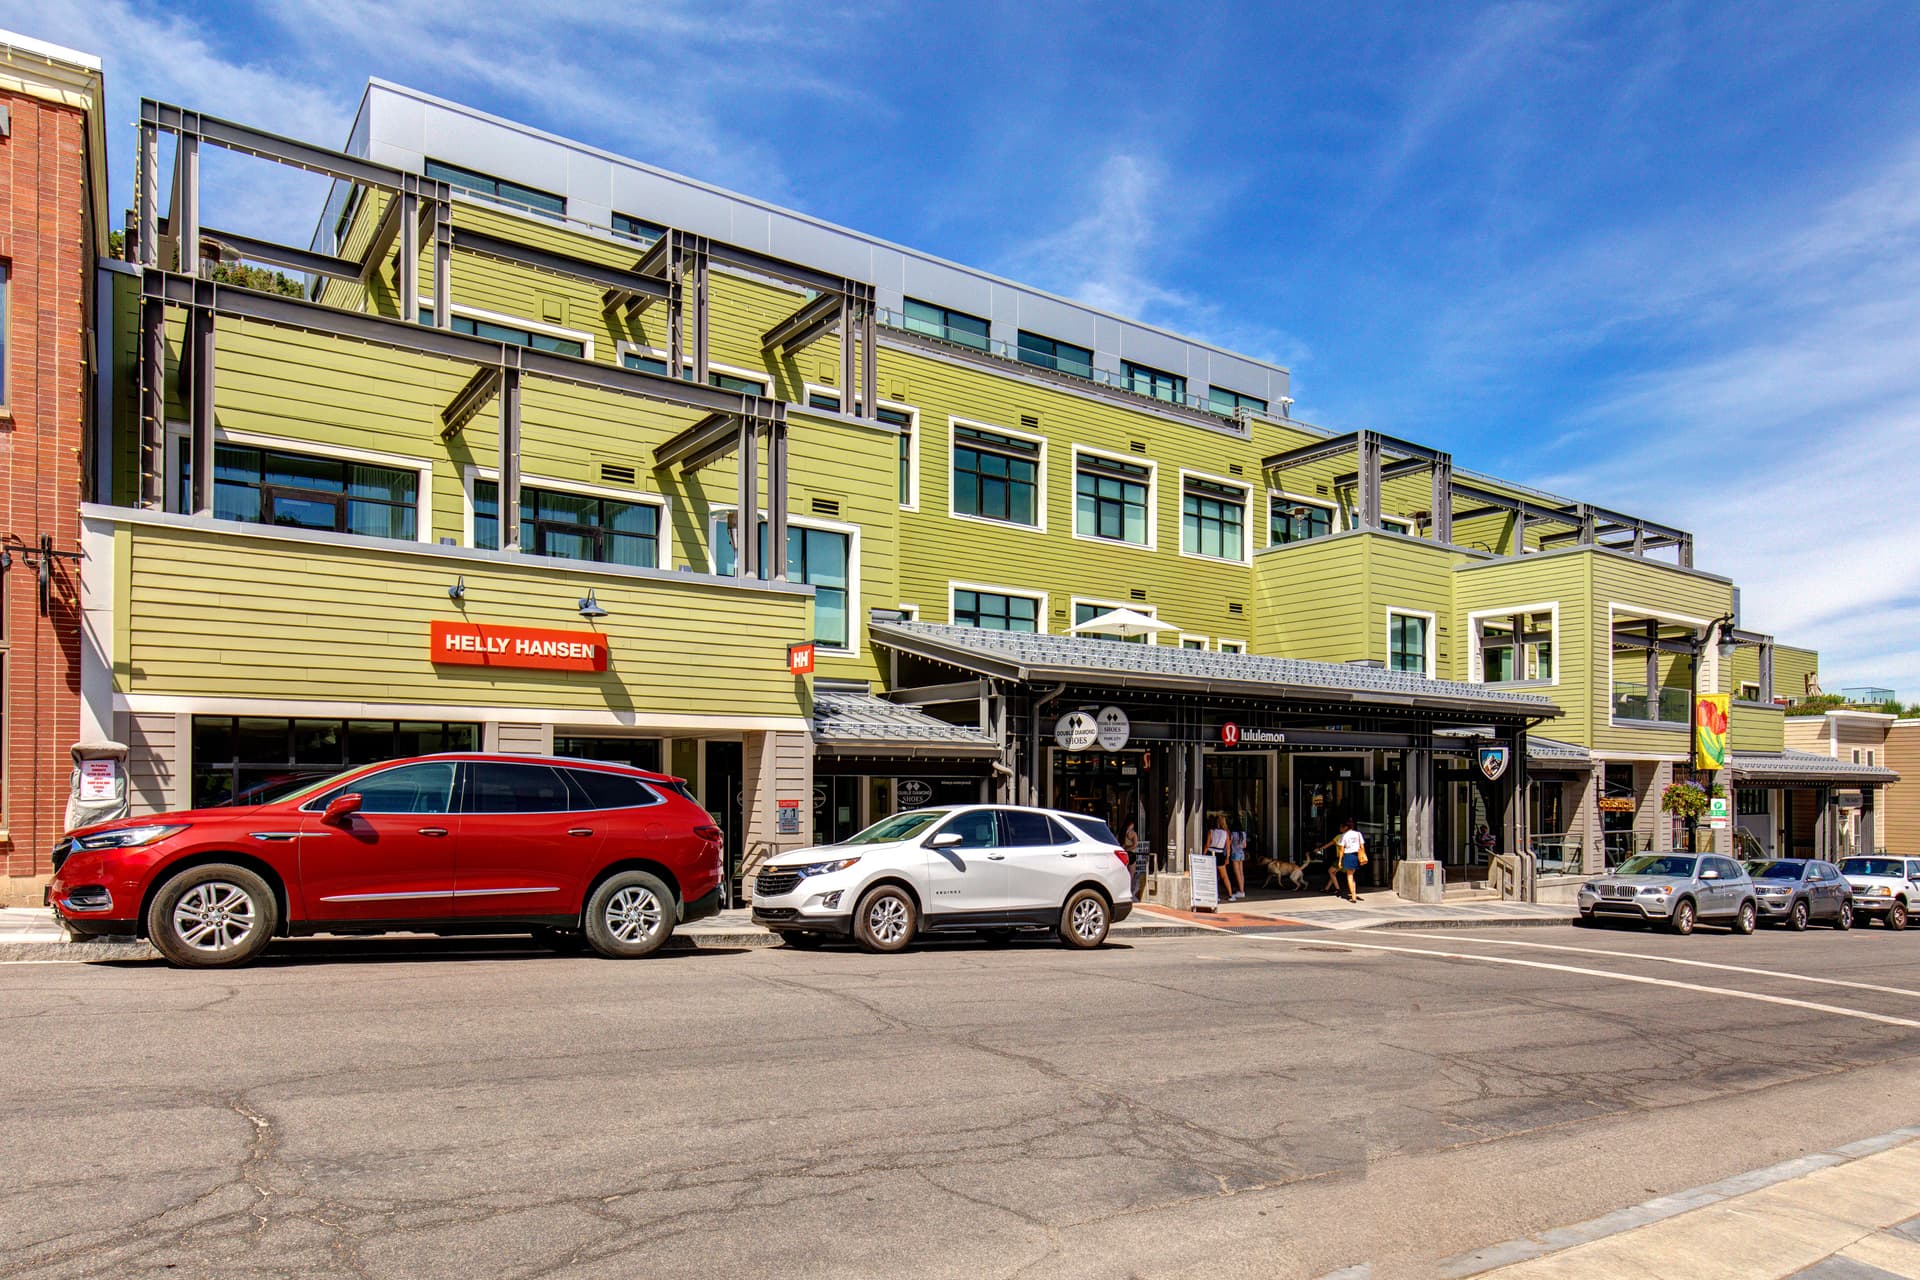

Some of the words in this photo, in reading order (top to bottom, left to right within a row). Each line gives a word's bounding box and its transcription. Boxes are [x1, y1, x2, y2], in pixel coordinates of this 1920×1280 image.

[445, 634, 511, 653] HELLY
[515, 639, 595, 659] HANSEN
[793, 650, 809, 669] HH
[1065, 737, 1088, 745] SHOES
[1241, 728, 1285, 743] lululemon
